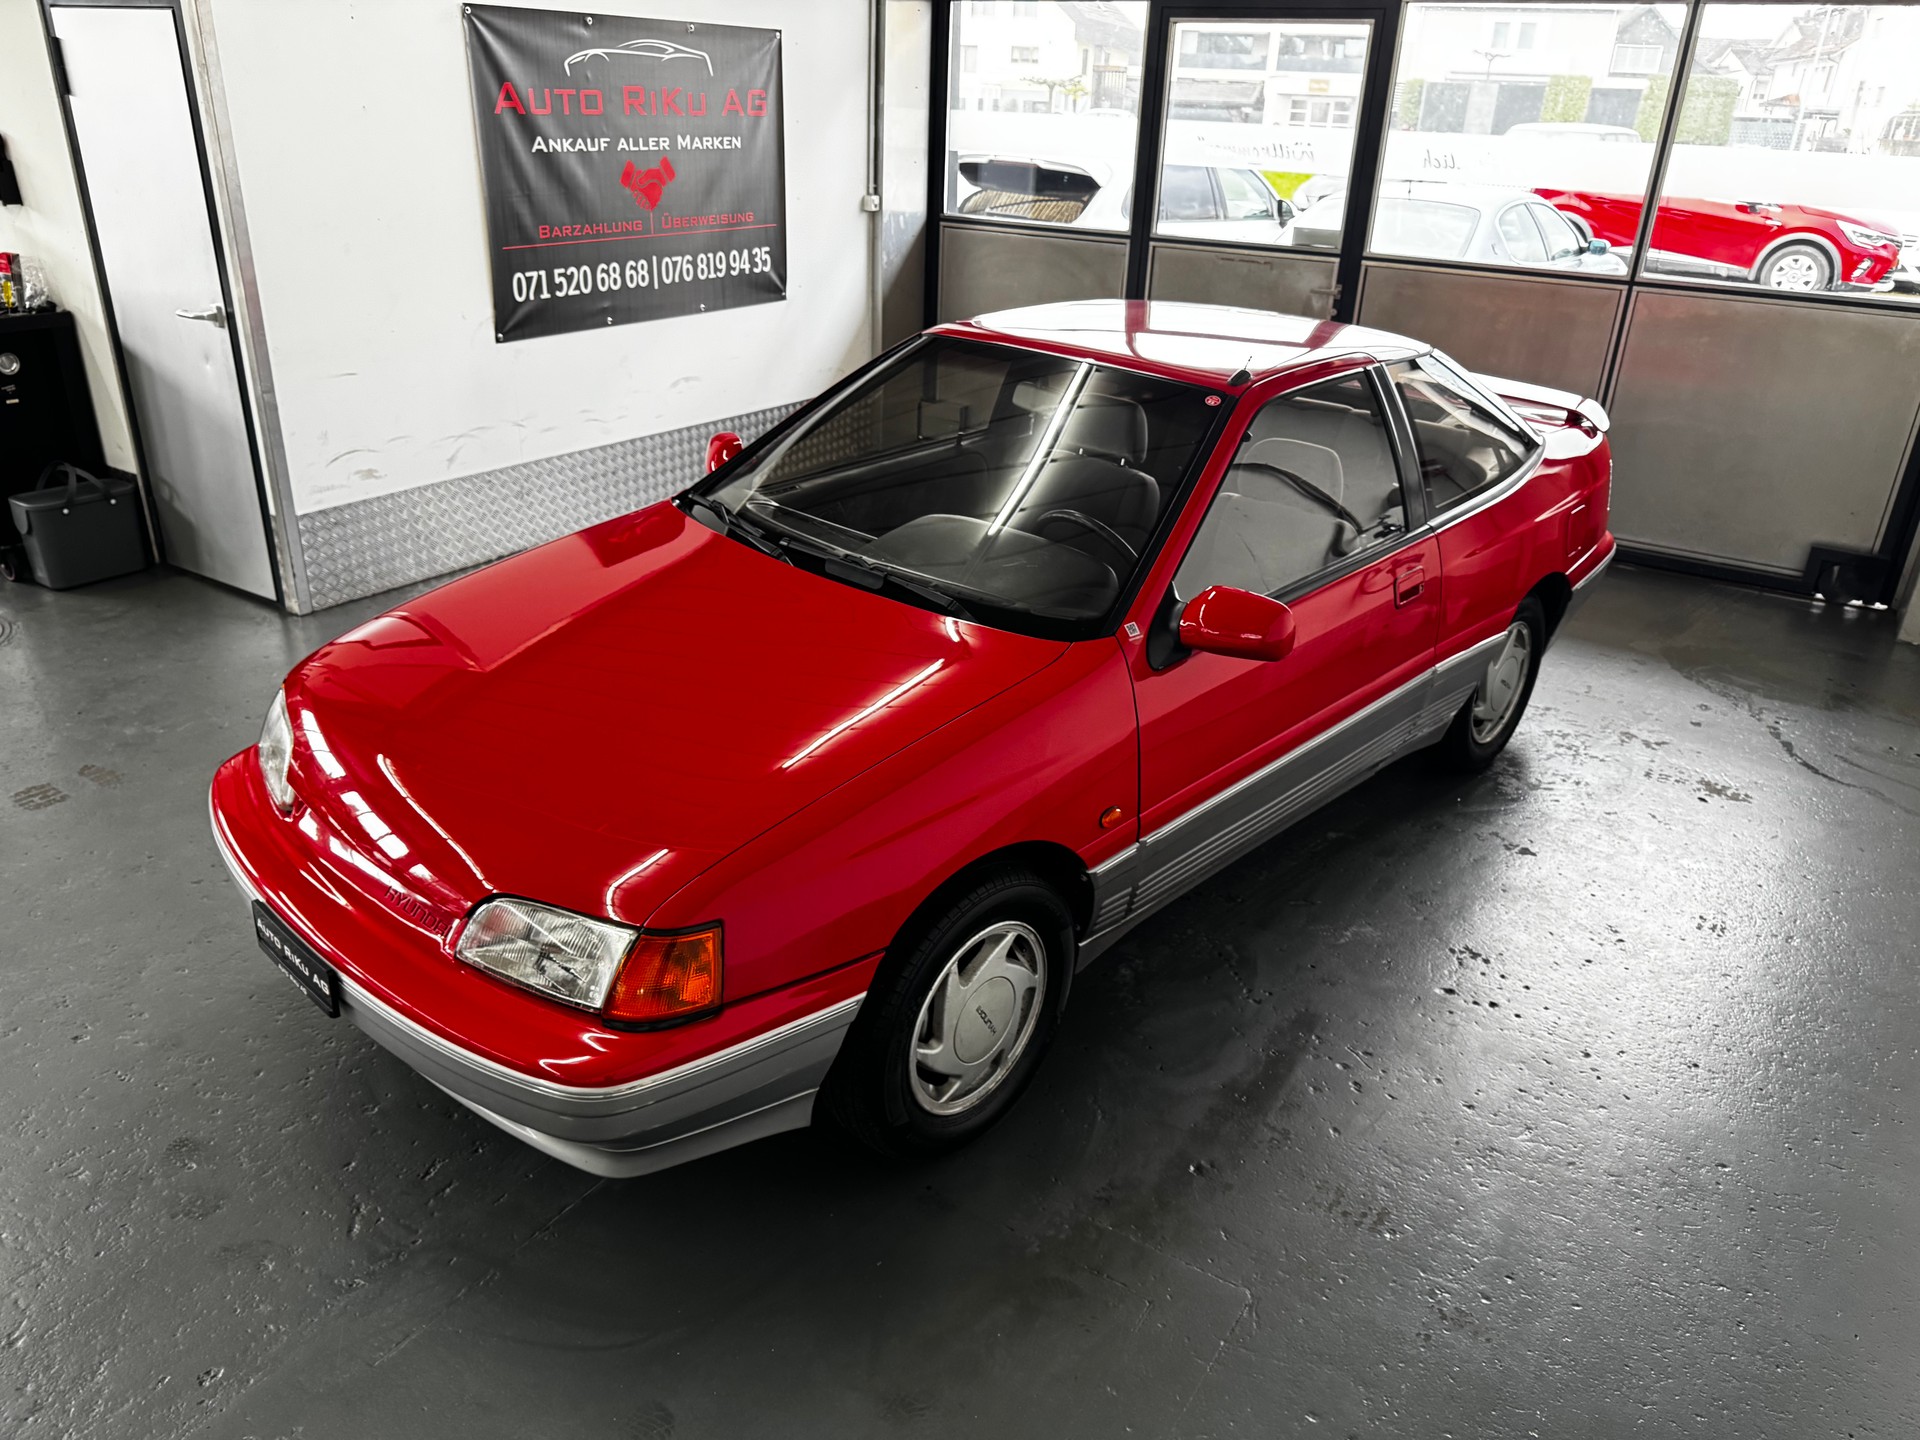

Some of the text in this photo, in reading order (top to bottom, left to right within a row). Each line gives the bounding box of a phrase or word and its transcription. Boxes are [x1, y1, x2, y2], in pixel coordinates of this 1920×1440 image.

[494, 82, 603, 115] AUTO
[721, 88, 767, 117] AG
[531, 134, 742, 153] ANKAUF ALLER MARKEN
[539, 212, 755, 239] BARZAHLUNG ÜBERWEISUNG
[512, 270, 551, 303] 071
[553, 265, 593, 297] 520
[596, 262, 622, 292] 68
[624, 259, 650, 289] 68
[661, 254, 694, 285] 076
[697, 251, 727, 280] 819
[729, 248, 751, 276] 94
[752, 246, 772, 273] 35
[312, 973, 331, 996] AG
